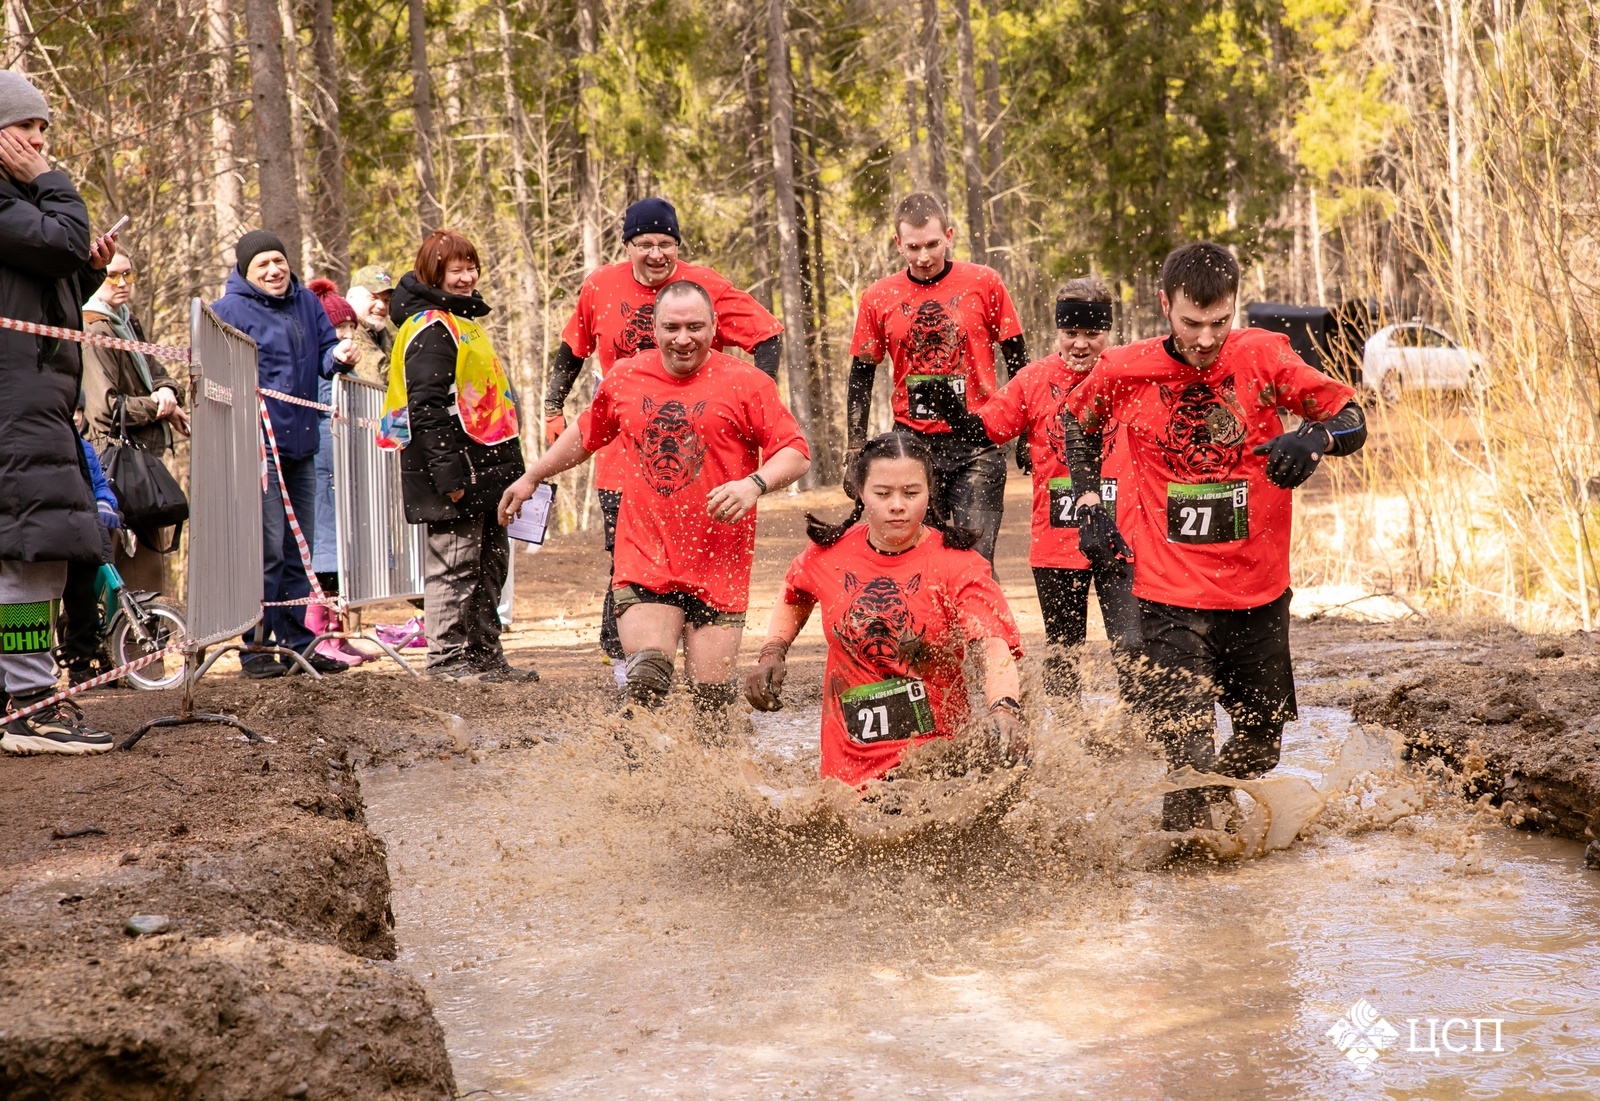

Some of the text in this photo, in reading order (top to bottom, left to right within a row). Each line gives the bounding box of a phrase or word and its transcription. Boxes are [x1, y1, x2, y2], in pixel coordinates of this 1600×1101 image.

[956, 381, 962, 393] 1
[1105, 486, 1113, 499] 4
[1236, 490, 1244, 505] 5
[1059, 496, 1079, 521] 2
[1180, 507, 1212, 536] 27
[0, 629, 51, 651] ОНК
[910, 683, 921, 698] 6
[858, 705, 890, 740] 27
